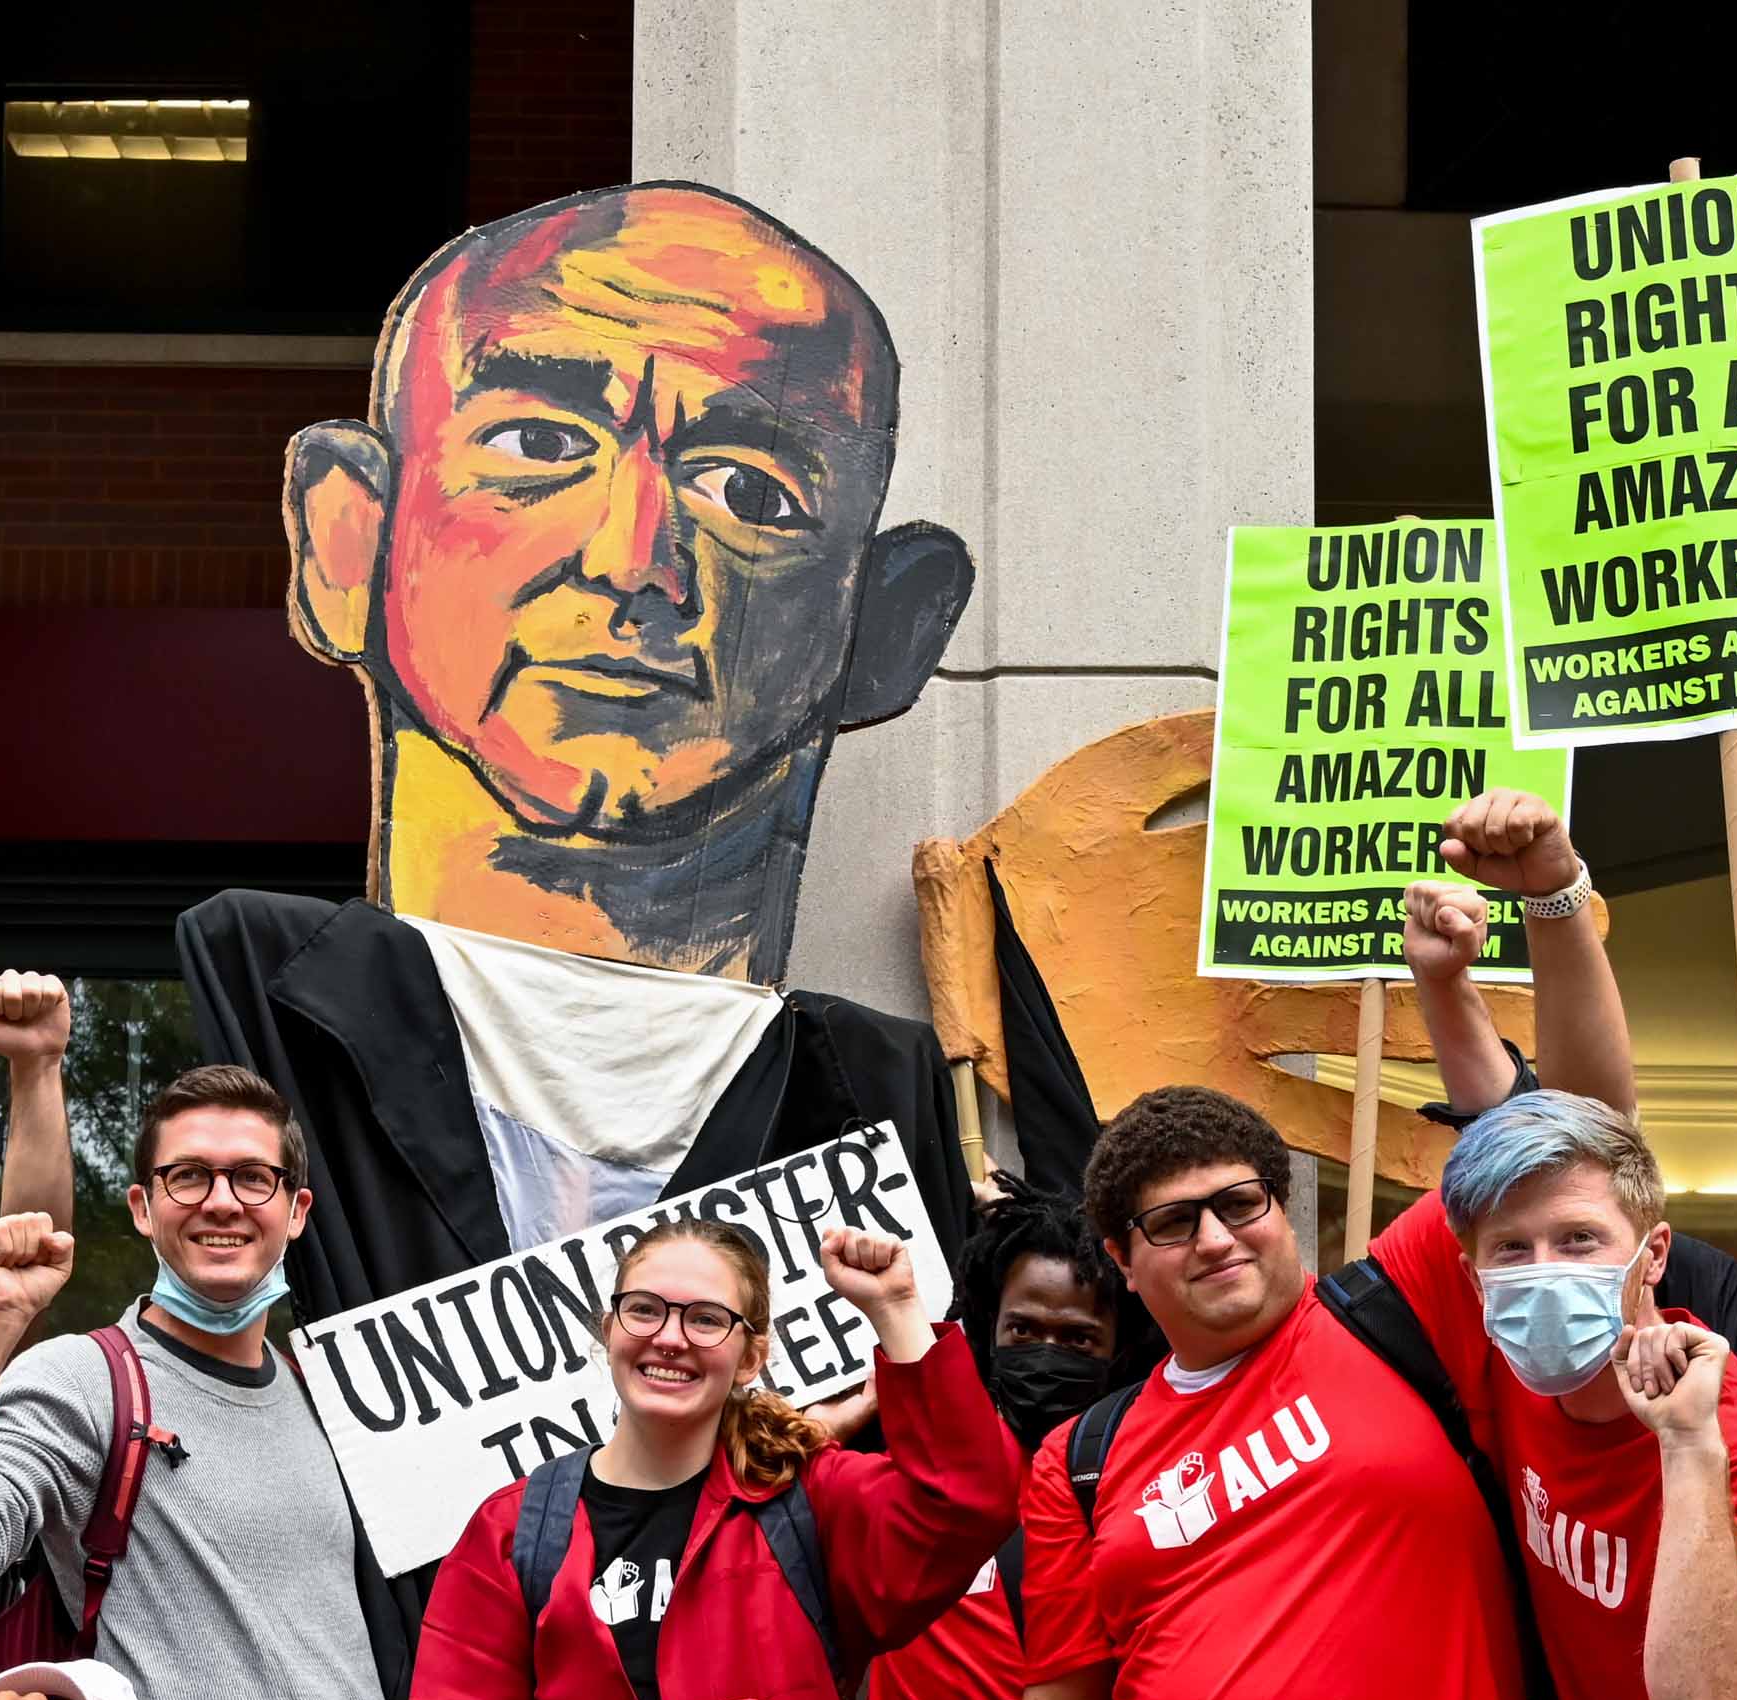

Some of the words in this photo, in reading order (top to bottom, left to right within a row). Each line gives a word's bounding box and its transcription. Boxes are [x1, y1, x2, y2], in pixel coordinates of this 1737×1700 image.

[1569, 366, 1697, 454] FOR
[1307, 527, 1484, 592] UNION
[1292, 598, 1490, 663] RIGHTS
[1530, 633, 1711, 684] WORKERS
[1284, 672, 1387, 734] FOR
[1405, 670, 1506, 729] ALL
[1572, 671, 1726, 719] AGAINST
[1274, 747, 1487, 804] AMAZON
[1241, 822, 1448, 877] WORKER
[1221, 898, 1369, 924] WORKERS
[1250, 932, 1375, 959] AGAINST
[315, 1237, 609, 1432] UNION
[1224, 1394, 1331, 1512] ALU
[1552, 1511, 1627, 1609] ALU
